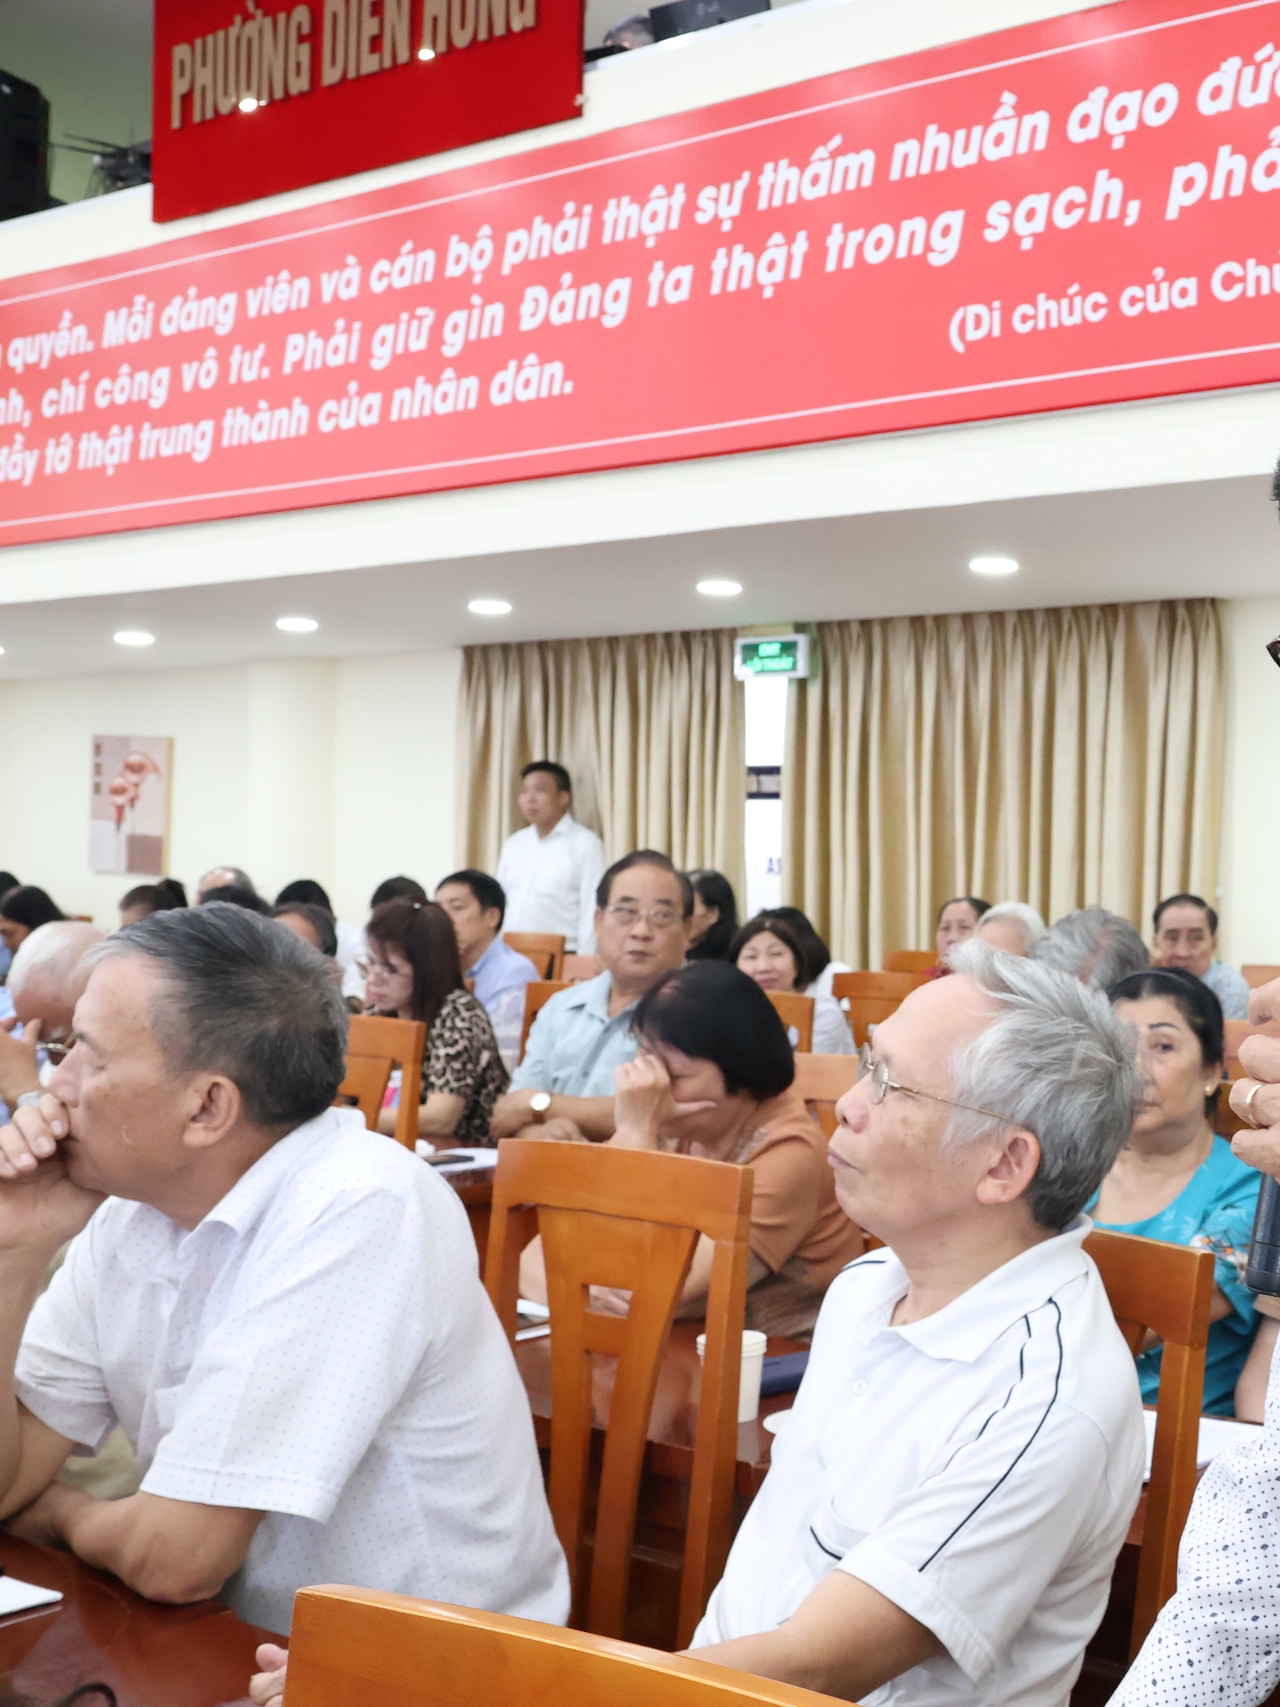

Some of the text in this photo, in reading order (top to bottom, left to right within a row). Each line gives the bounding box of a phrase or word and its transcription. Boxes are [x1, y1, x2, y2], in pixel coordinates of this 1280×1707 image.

[6, 309, 95, 374] quyền.
[101, 294, 156, 349] Mỗi
[159, 285, 239, 337] đảng
[245, 269, 311, 319] viên
[319, 253, 362, 304] và
[368, 240, 437, 294] cán
[444, 223, 495, 285] bộ
[500, 200, 593, 276] phải
[601, 182, 687, 249] thật
[694, 170, 751, 233] sự
[757, 133, 876, 211] thấm
[889, 90, 1050, 182] nhuần
[1066, 82, 1179, 150] đạo
[41, 370, 90, 419] chí
[94, 363, 172, 410] công
[181, 345, 219, 393] vô
[228, 342, 271, 385] tư.
[282, 317, 362, 376] Phải
[369, 306, 436, 371] giữ
[440, 293, 505, 358] gìn
[518, 271, 633, 332] Đảng
[646, 260, 694, 308] ta
[709, 229, 809, 299] thật
[824, 208, 965, 273] trong
[983, 168, 1141, 251] sạch,
[948, 300, 1001, 354] (Di
[1011, 283, 1108, 334] chúc
[1119, 266, 1198, 317] của
[77, 424, 135, 477] thật
[138, 419, 216, 464] trung
[221, 396, 310, 448] thành
[317, 380, 383, 434] của
[389, 366, 480, 423] nhân
[488, 352, 574, 407] dân.
